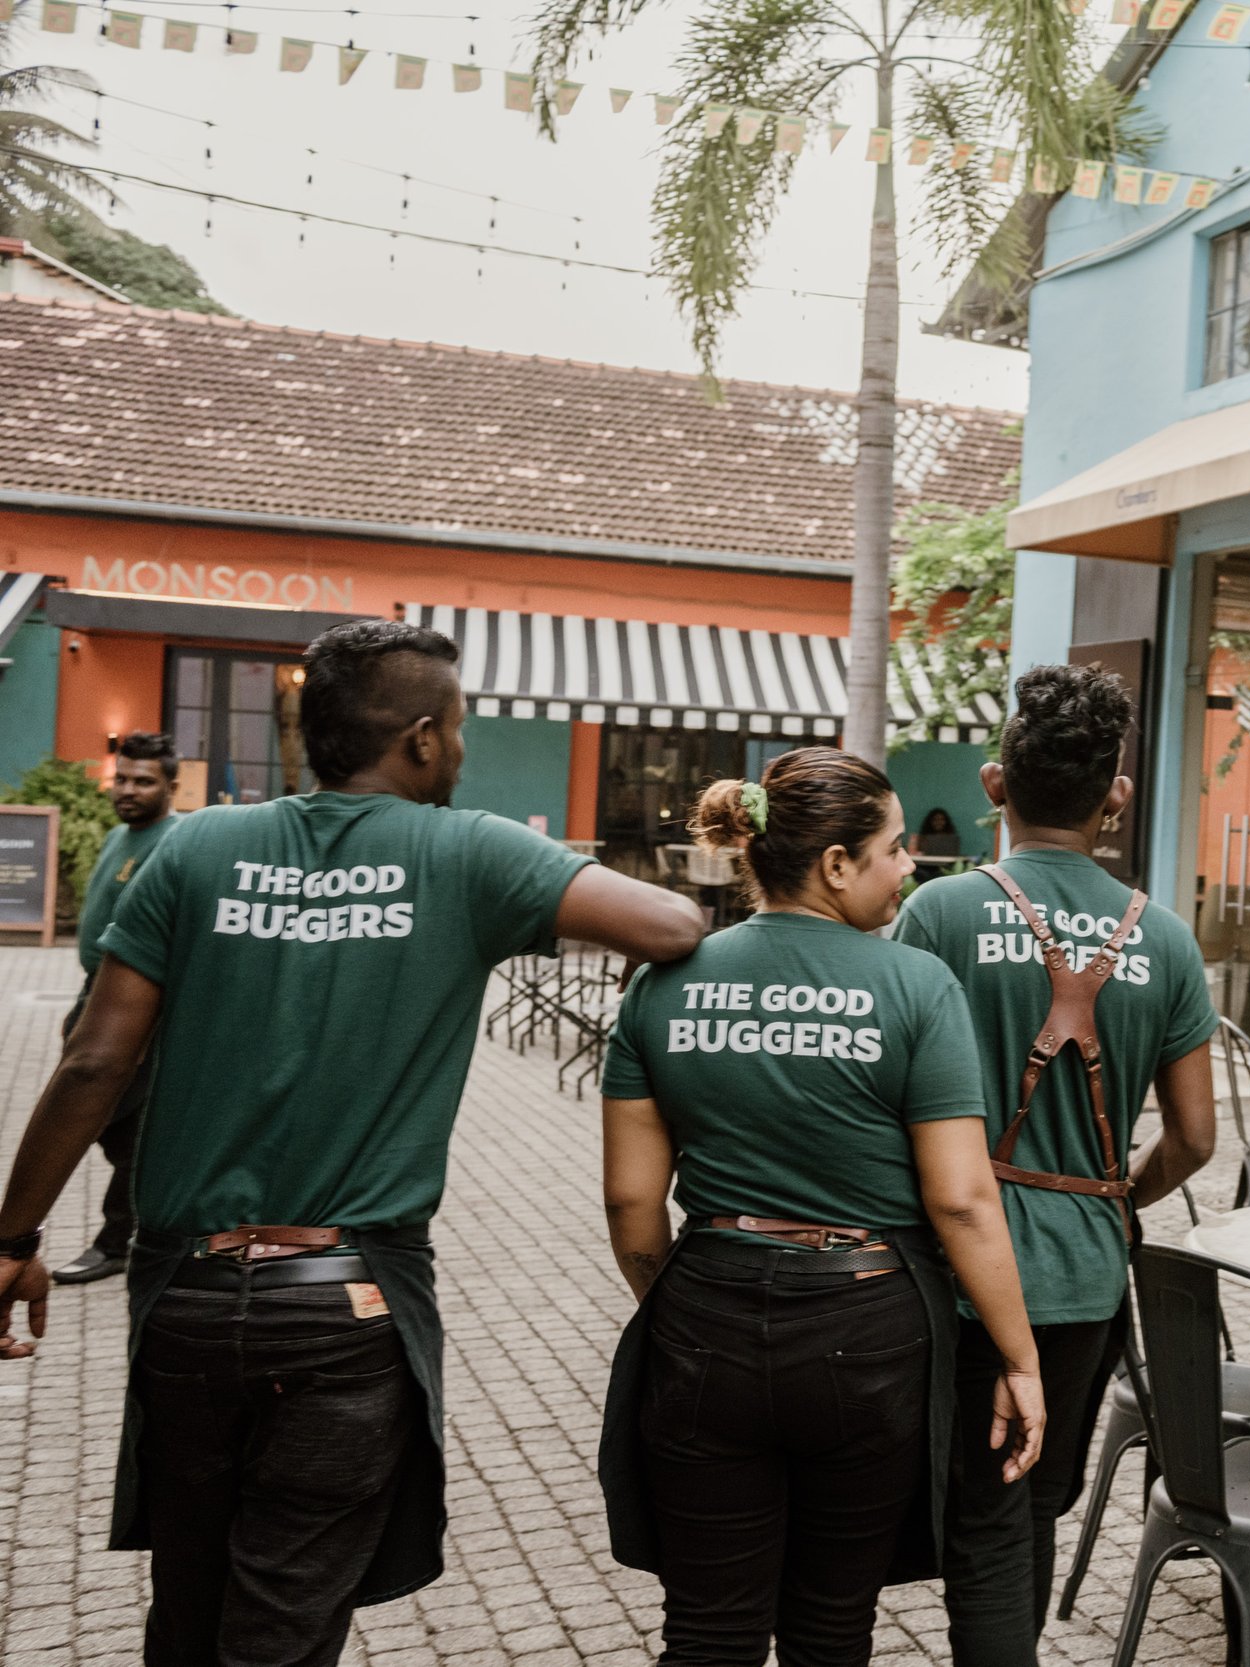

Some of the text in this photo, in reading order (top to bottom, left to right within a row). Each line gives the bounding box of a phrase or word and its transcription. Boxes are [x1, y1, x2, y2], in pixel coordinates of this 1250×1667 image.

[81, 555, 352, 610] MONSOON
[233, 860, 406, 899] THE GOOD
[213, 897, 414, 943] BUGGERS
[682, 982, 874, 1016] THE GOOD
[667, 1018, 883, 1063] BUGGERS
